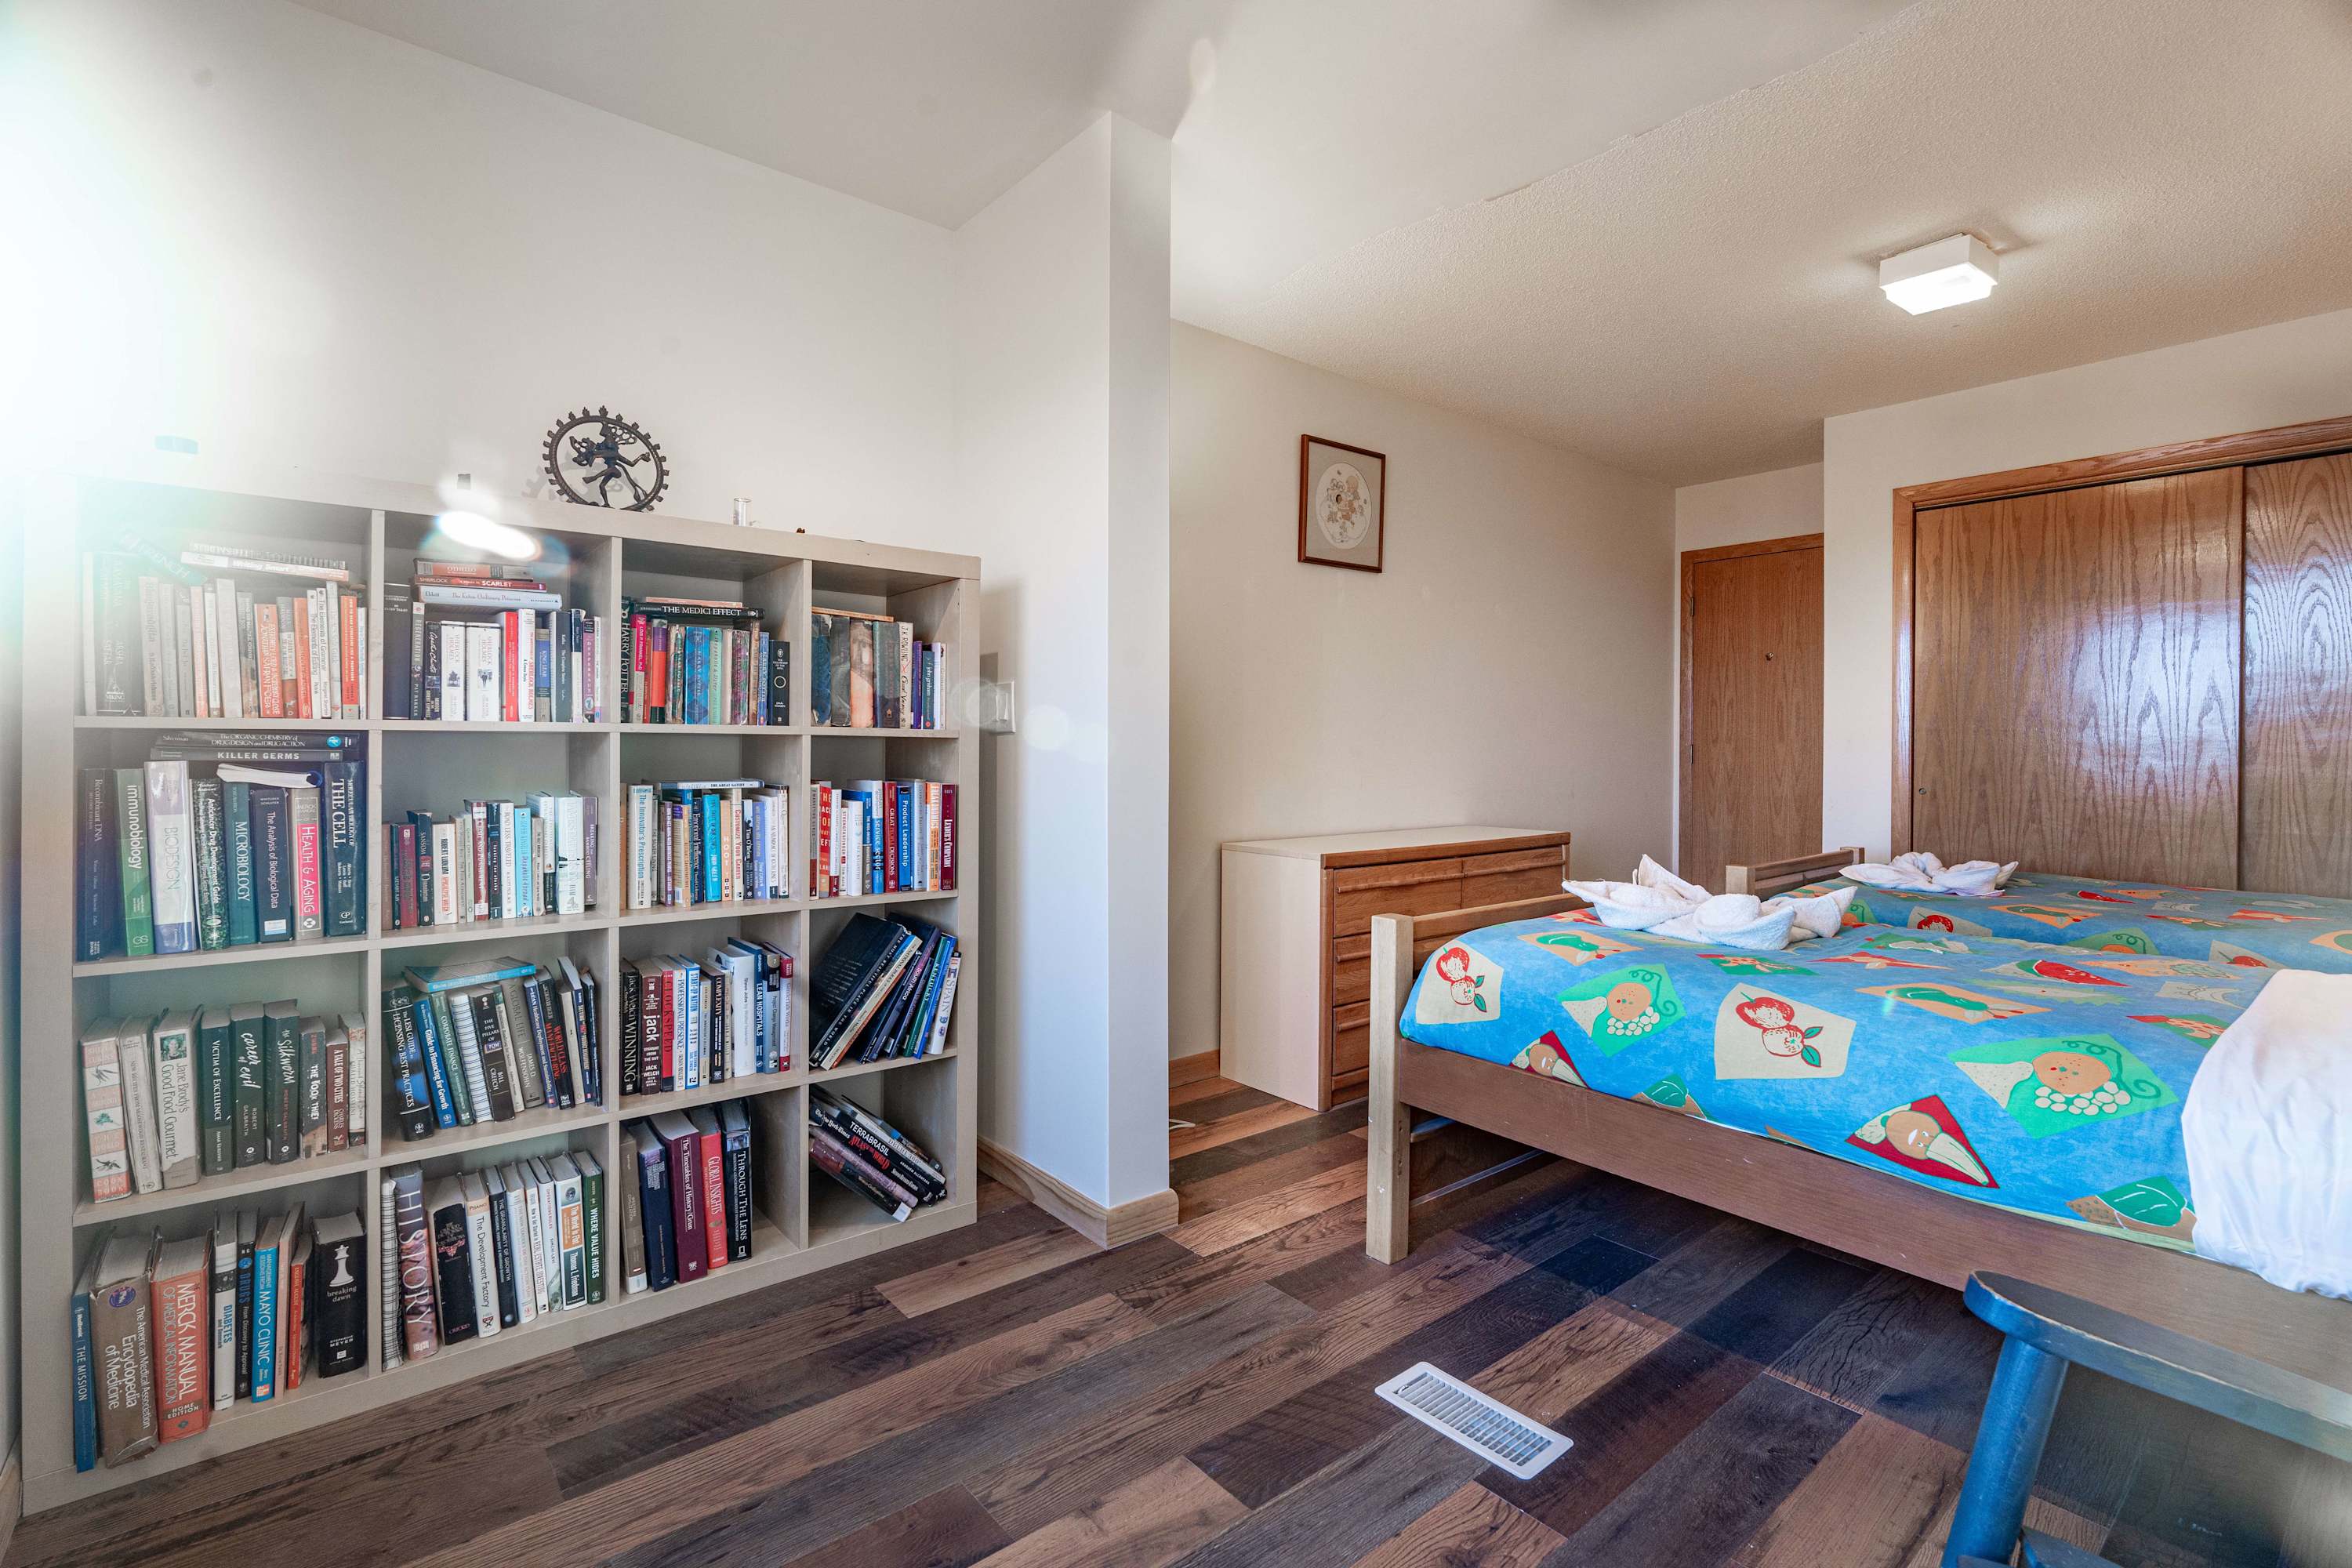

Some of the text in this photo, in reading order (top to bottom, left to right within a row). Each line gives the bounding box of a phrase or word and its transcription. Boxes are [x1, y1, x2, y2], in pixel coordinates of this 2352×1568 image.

[662, 605, 680, 614] THE
[621, 622, 630, 692] HARRY POTTER
[94, 779, 103, 841] Recombinant DNA
[126, 785, 144, 869] immunobiology
[208, 798, 216, 829] Anticancer
[267, 812, 276, 824] The
[332, 779, 347, 848] THE CELL
[164, 827, 182, 891] BIODESIGN
[209, 831, 217, 846] Drug
[267, 826, 277, 851] Analysis
[301, 826, 315, 863] HEALTH
[210, 847, 220, 885] Development
[235, 821, 250, 901] MICROBIOLOGY
[268, 861, 279, 891] Biological
[637, 842, 646, 879] Prescription
[270, 893, 279, 908] Data
[303, 879, 317, 913] AGING
[628, 975, 637, 993] Jack
[925, 964, 940, 1001] KENTUCKY
[941, 978, 955, 1013] SPAIN
[407, 1033, 416, 1054] GUIDE
[441, 1015, 458, 1071] CORPORATE FINANCE
[643, 1015, 660, 1043] jack
[213, 1068, 220, 1077] OF
[392, 1014, 415, 1108] LICENSING BEST PRACTICES
[424, 1029, 434, 1047] Guide
[429, 1053, 441, 1080] Financing
[437, 1089, 449, 1109] Growth
[623, 1021, 637, 1082] WINNING
[176, 1062, 190, 1113] Jane Brody's
[241, 1066, 262, 1089] evil
[334, 1075, 343, 1087] TWO
[334, 1087, 343, 1103] CITIES
[162, 1064, 177, 1159] Good Food Gourmet
[849, 1121, 890, 1156] TERRABRASIL
[708, 1156, 723, 1215] GLOBAL INSIGHTS
[737, 1151, 748, 1240] THROUGH THE LENS
[397, 1189, 432, 1325] HISTORY
[477, 1233, 488, 1281] Development
[481, 1283, 490, 1308] Factory
[177, 1283, 197, 1401] MERCK MANUAL
[223, 1304, 233, 1343] DIABETES
[257, 1290, 270, 1366] MAYO CLINIC
[136, 1305, 151, 1428] The American Medical Association
[163, 1286, 177, 1405] OF MEDICAL INFORMATION
[76, 1345, 88, 1401] THE MISSION
[104, 1345, 123, 1410] of Medicine
[120, 1335, 139, 1408] Encyclopedia
